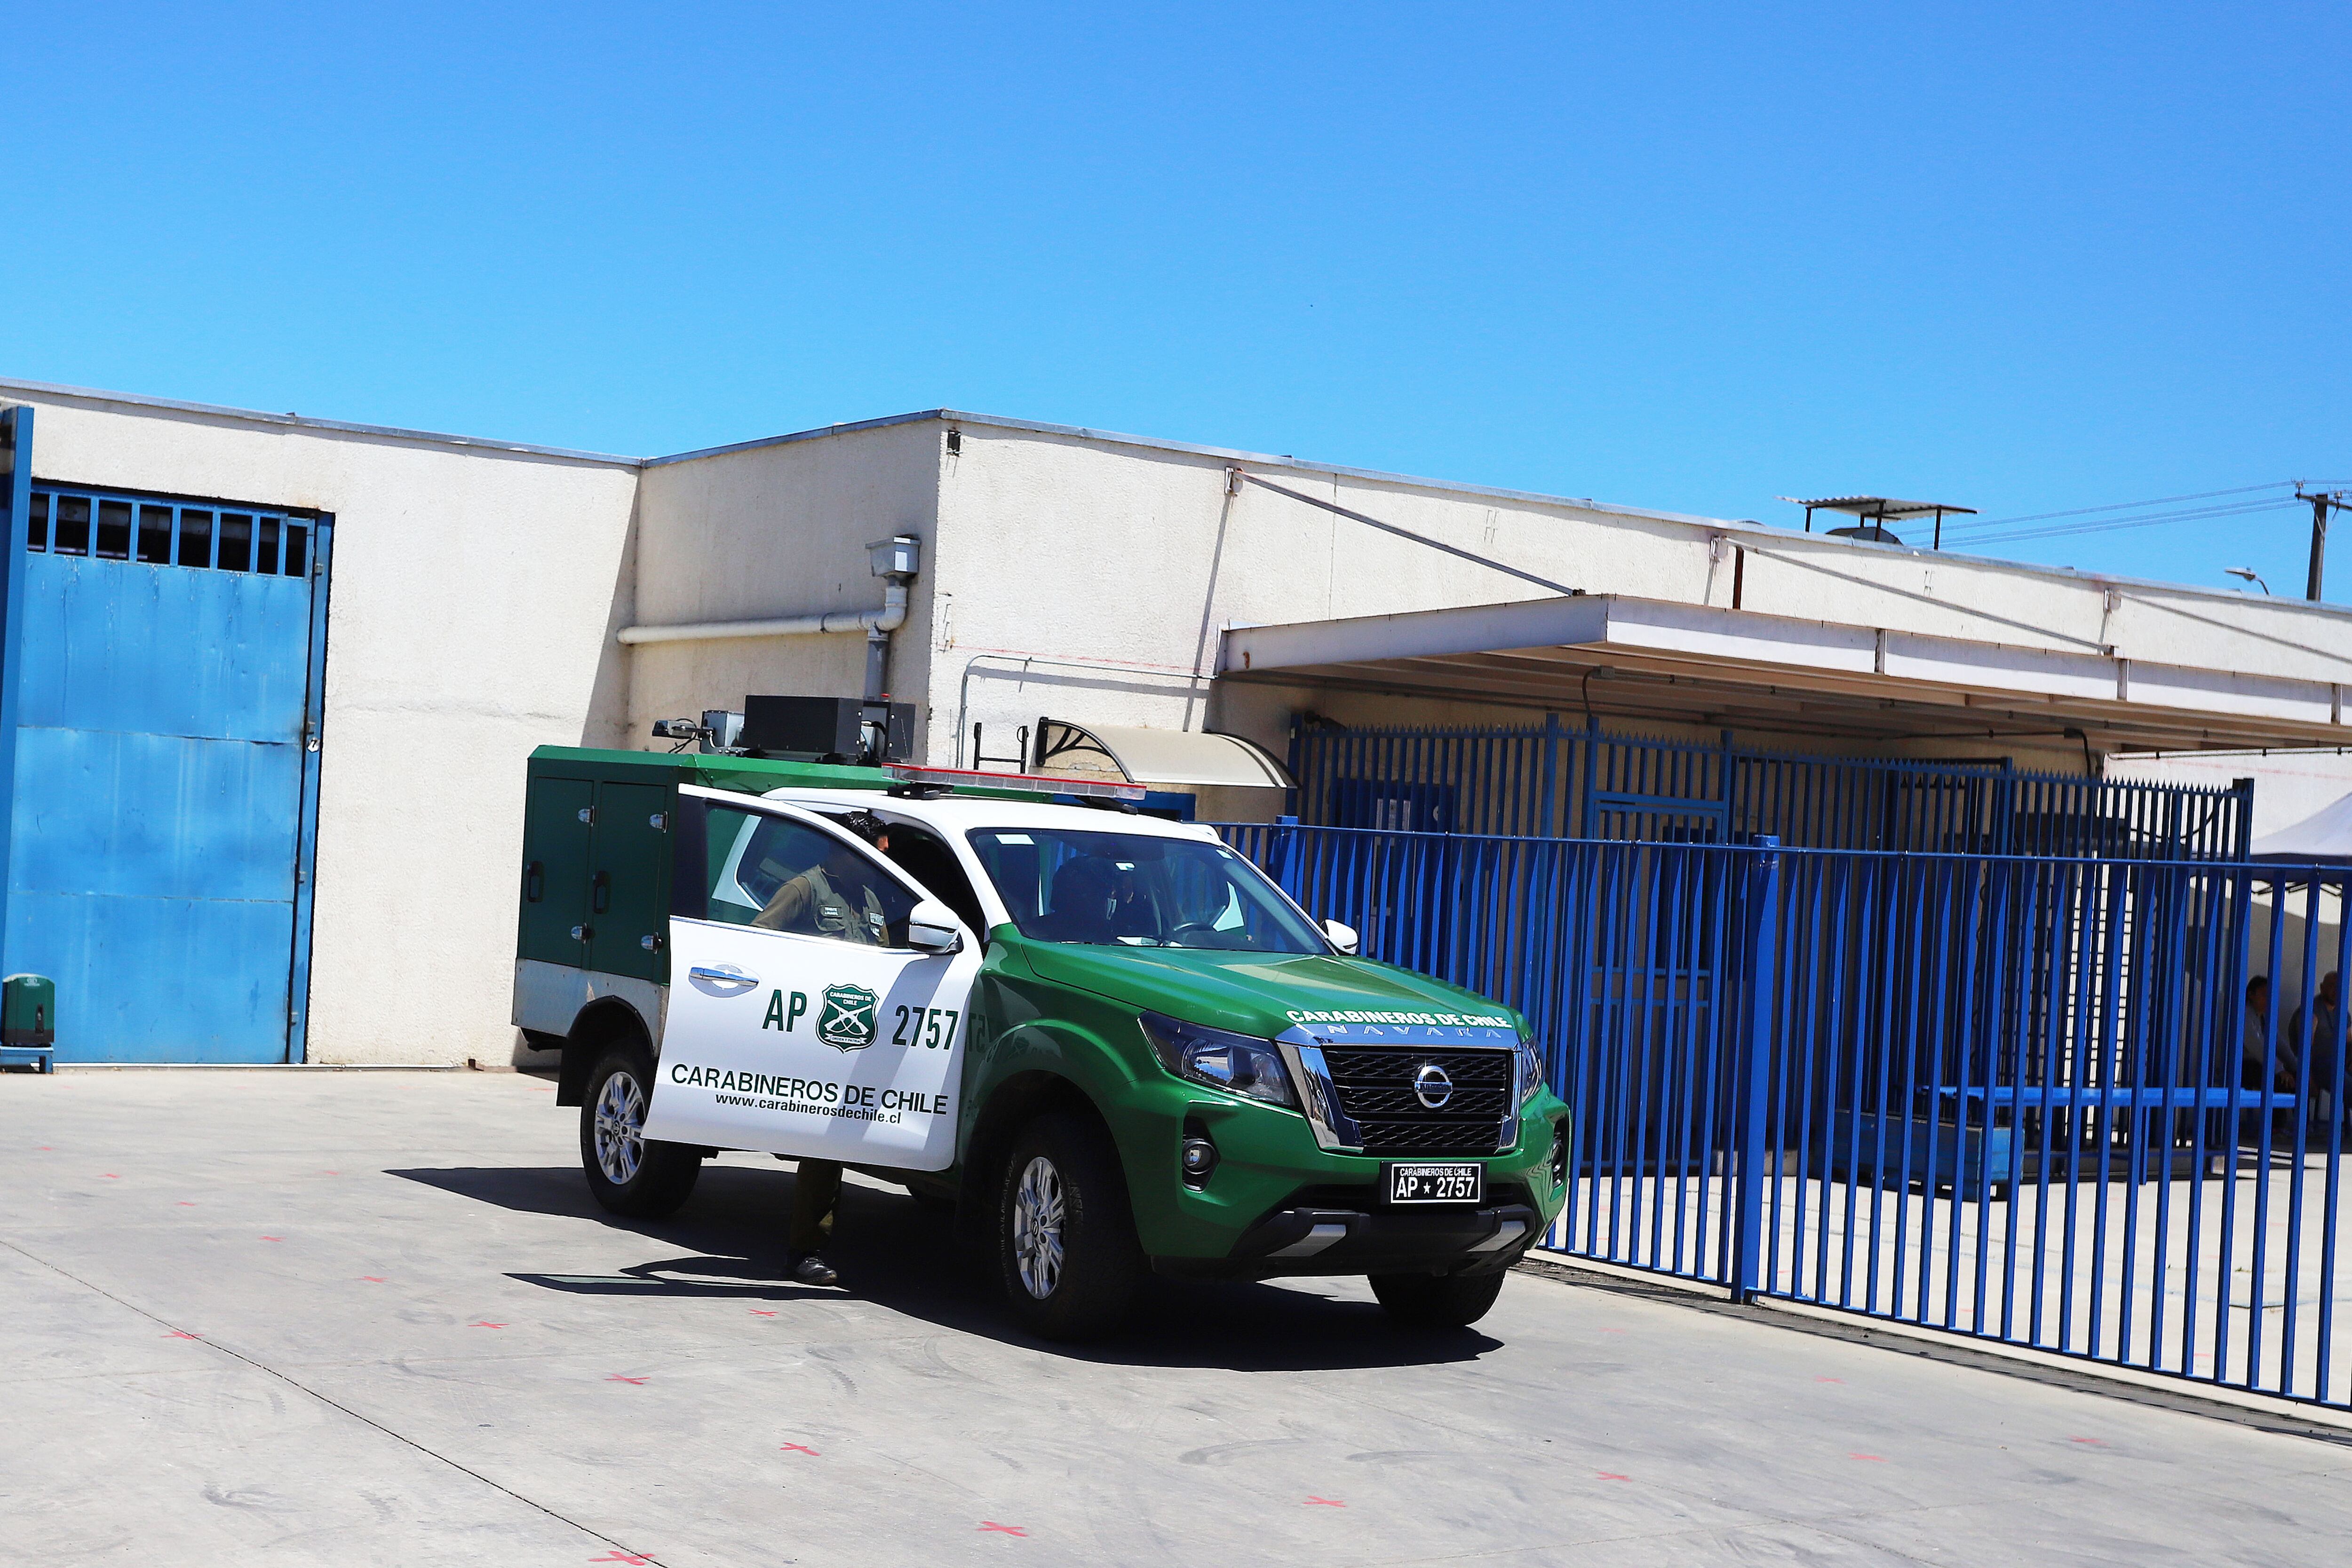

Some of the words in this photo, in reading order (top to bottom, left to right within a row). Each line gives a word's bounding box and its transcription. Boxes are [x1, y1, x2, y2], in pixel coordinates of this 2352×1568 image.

[830, 992, 864, 1000] CARABINEROS
[762, 989, 807, 1032] AP
[1286, 1011, 1437, 1025] CARABINEROS
[1433, 1013, 1465, 1026] DE
[1461, 1014, 1512, 1028] CHILE
[892, 1004, 959, 1050] 2757
[1327, 1024, 1502, 1039] NAVARA
[671, 1063, 839, 1103] CARABINEROS
[844, 1084, 876, 1107] DE
[881, 1089, 948, 1115] CHILE
[715, 1094, 901, 1124] www.carabinerosdechile.cl
[1399, 1168, 1444, 1176] CARABINEROS
[1444, 1168, 1453, 1176] DE
[1454, 1167, 1472, 1176] CHILE
[1395, 1177, 1418, 1198] AP
[1436, 1177, 1475, 1197] 2757
